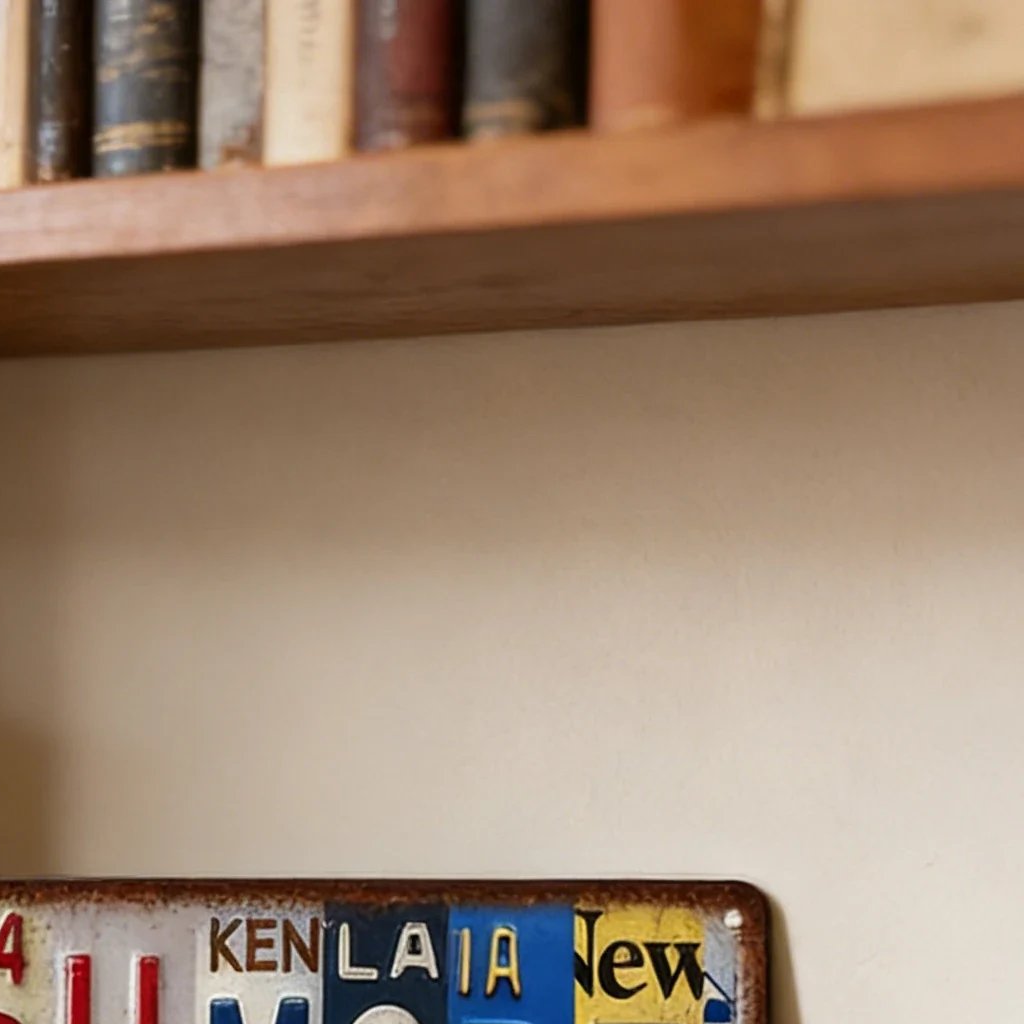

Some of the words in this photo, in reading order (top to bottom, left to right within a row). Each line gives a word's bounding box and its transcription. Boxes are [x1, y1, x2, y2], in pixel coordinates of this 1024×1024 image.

[209, 916, 320, 974] KEN
[338, 921, 440, 981] LA
[458, 926, 521, 996] IA
[574, 909, 706, 1001] New
